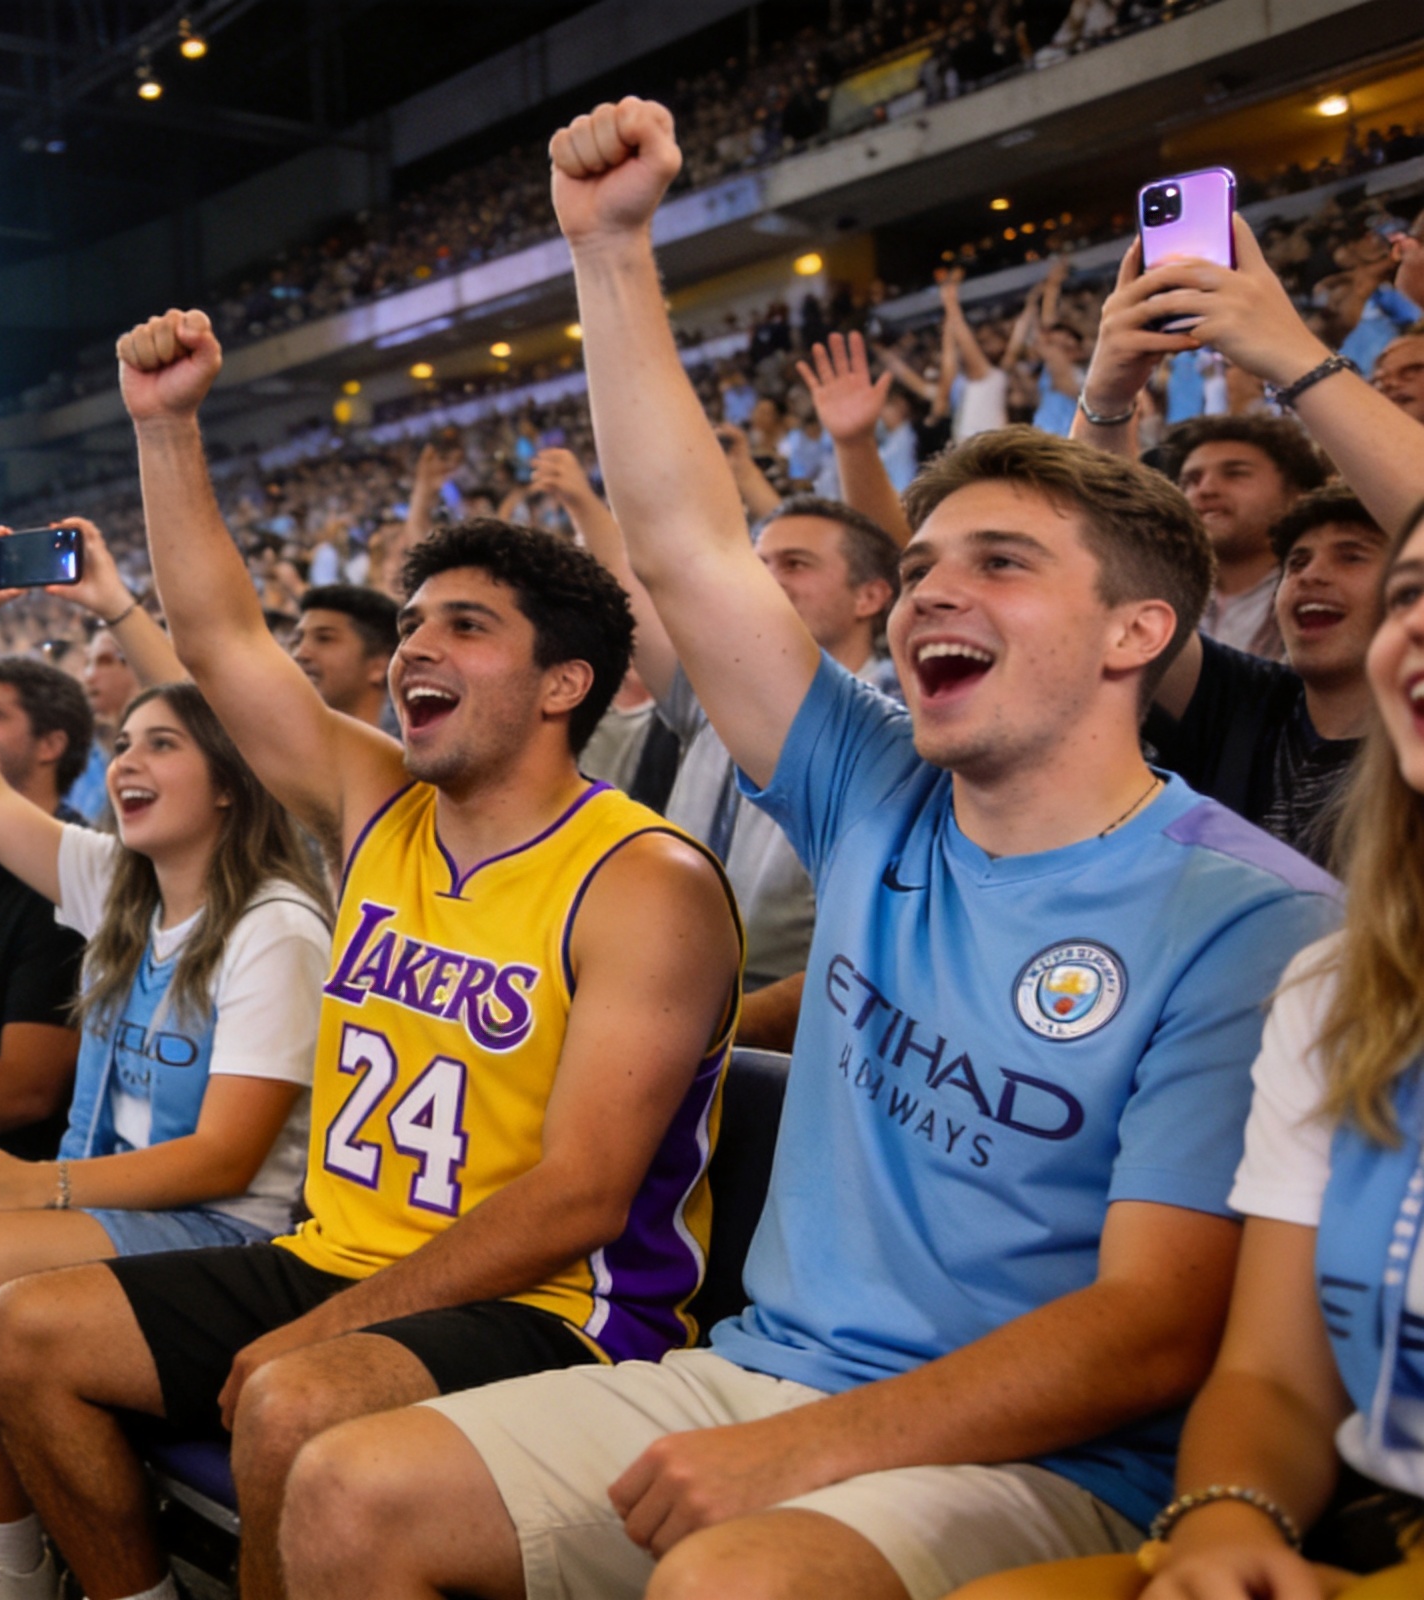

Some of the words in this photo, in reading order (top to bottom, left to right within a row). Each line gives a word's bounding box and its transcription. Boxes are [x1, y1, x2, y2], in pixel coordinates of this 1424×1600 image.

[323, 899, 541, 1053] LAKERS
[826, 954, 1085, 1141] ETIHAD
[323, 1022, 470, 1218] 24
